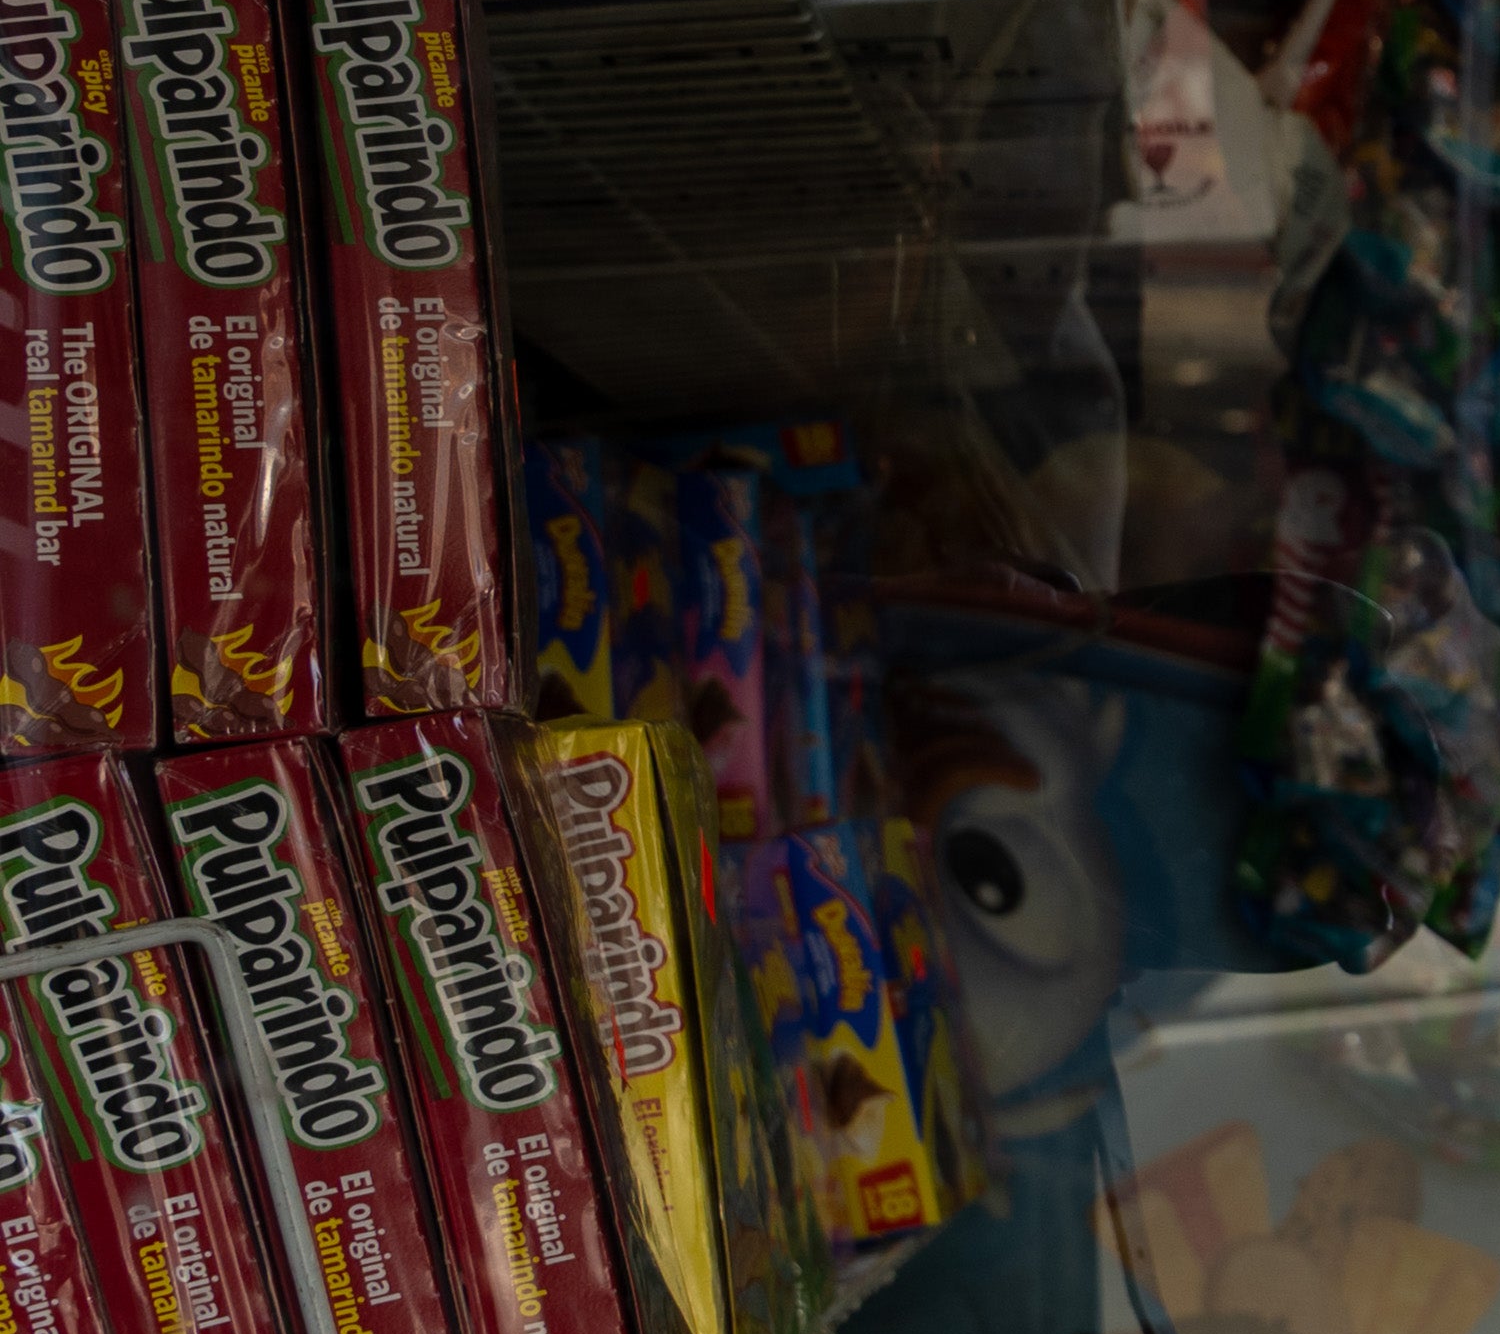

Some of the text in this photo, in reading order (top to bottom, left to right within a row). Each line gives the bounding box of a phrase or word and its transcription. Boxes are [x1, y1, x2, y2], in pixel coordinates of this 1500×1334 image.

[81, 59, 112, 115] spicy
[231, 44, 270, 123] picante
[254, 43, 272, 74] extra
[416, 31, 455, 109] picante
[440, 30, 456, 61] extra
[223, 315, 267, 450] El original
[411, 296, 455, 430] El original
[24, 329, 67, 566] real tamarind bar
[62, 322, 105, 528] The ORIGINAL
[188, 315, 245, 601] de tamarindo natural
[377, 297, 431, 576] de tamarindo natural
[301, 900, 351, 978] picante
[325, 897, 345, 928] extra
[359, 753, 563, 1111] Pulparindo
[483, 868, 530, 945] picante
[173, 783, 389, 1148] Pulparindo
[304, 1178, 333, 1216] de
[482, 1142, 509, 1177] de
[517, 1133, 575, 1266] El original
[1, 1215, 39, 1246] El
[127, 1204, 162, 1240] de
[163, 1192, 232, 1329] El original
[340, 1169, 402, 1307] El original
[492, 1178, 548, 1318] tamarindo
